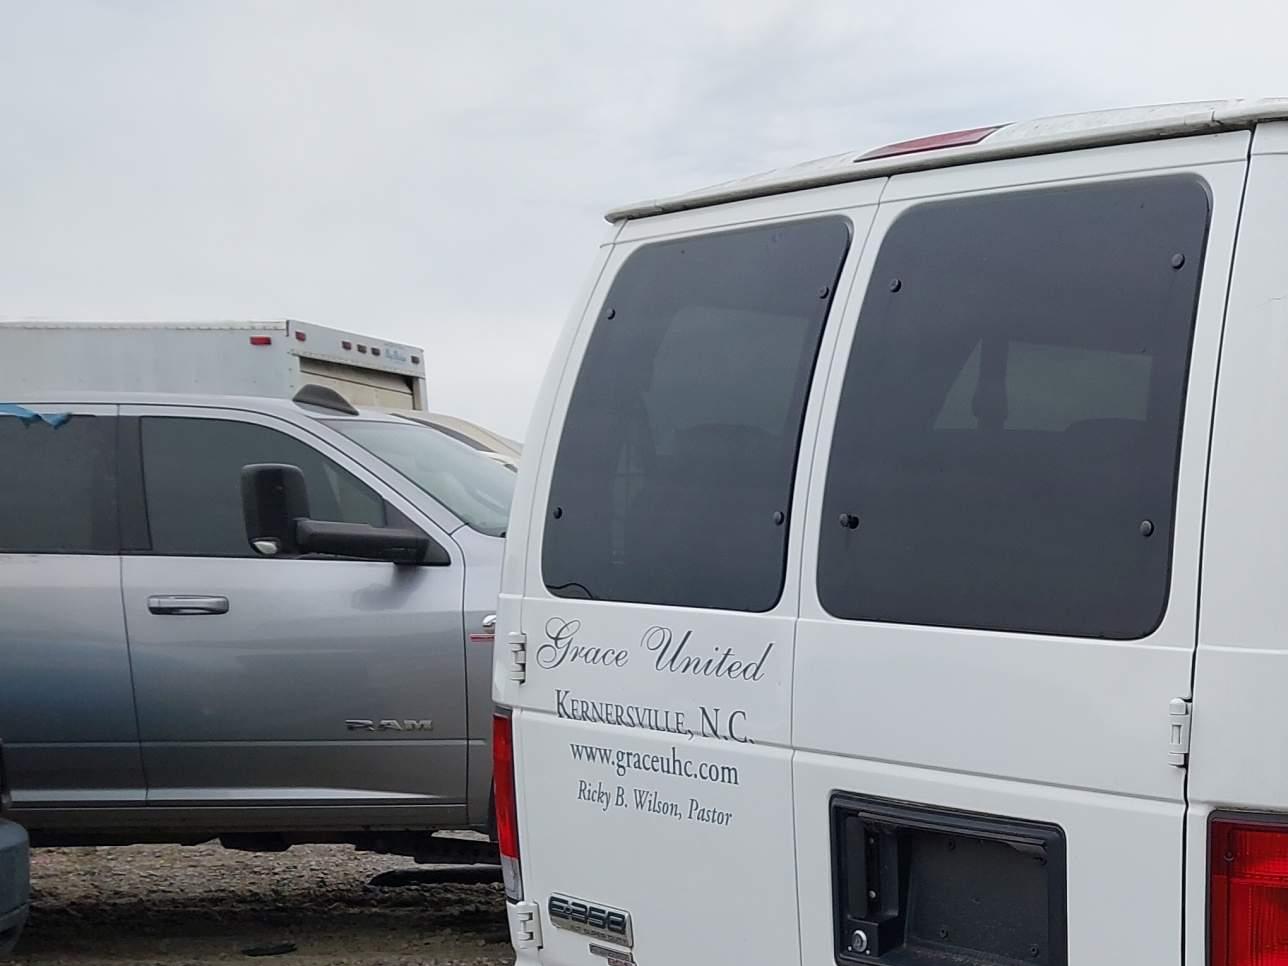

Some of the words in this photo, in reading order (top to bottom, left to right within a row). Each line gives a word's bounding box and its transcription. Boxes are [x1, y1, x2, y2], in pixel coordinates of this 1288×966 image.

[536, 617, 628, 669] Grace
[640, 625, 774, 682] United
[344, 719, 433, 731] RAM
[554, 689, 694, 740] KERNERSVILLE,
[699, 706, 756, 744] N.C.
[570, 743, 740, 785] www.graceuhc.com
[577, 780, 611, 811] Ricky
[615, 786, 628, 808] B.
[633, 788, 682, 820] Wilson,
[687, 798, 733, 826] Pastor
